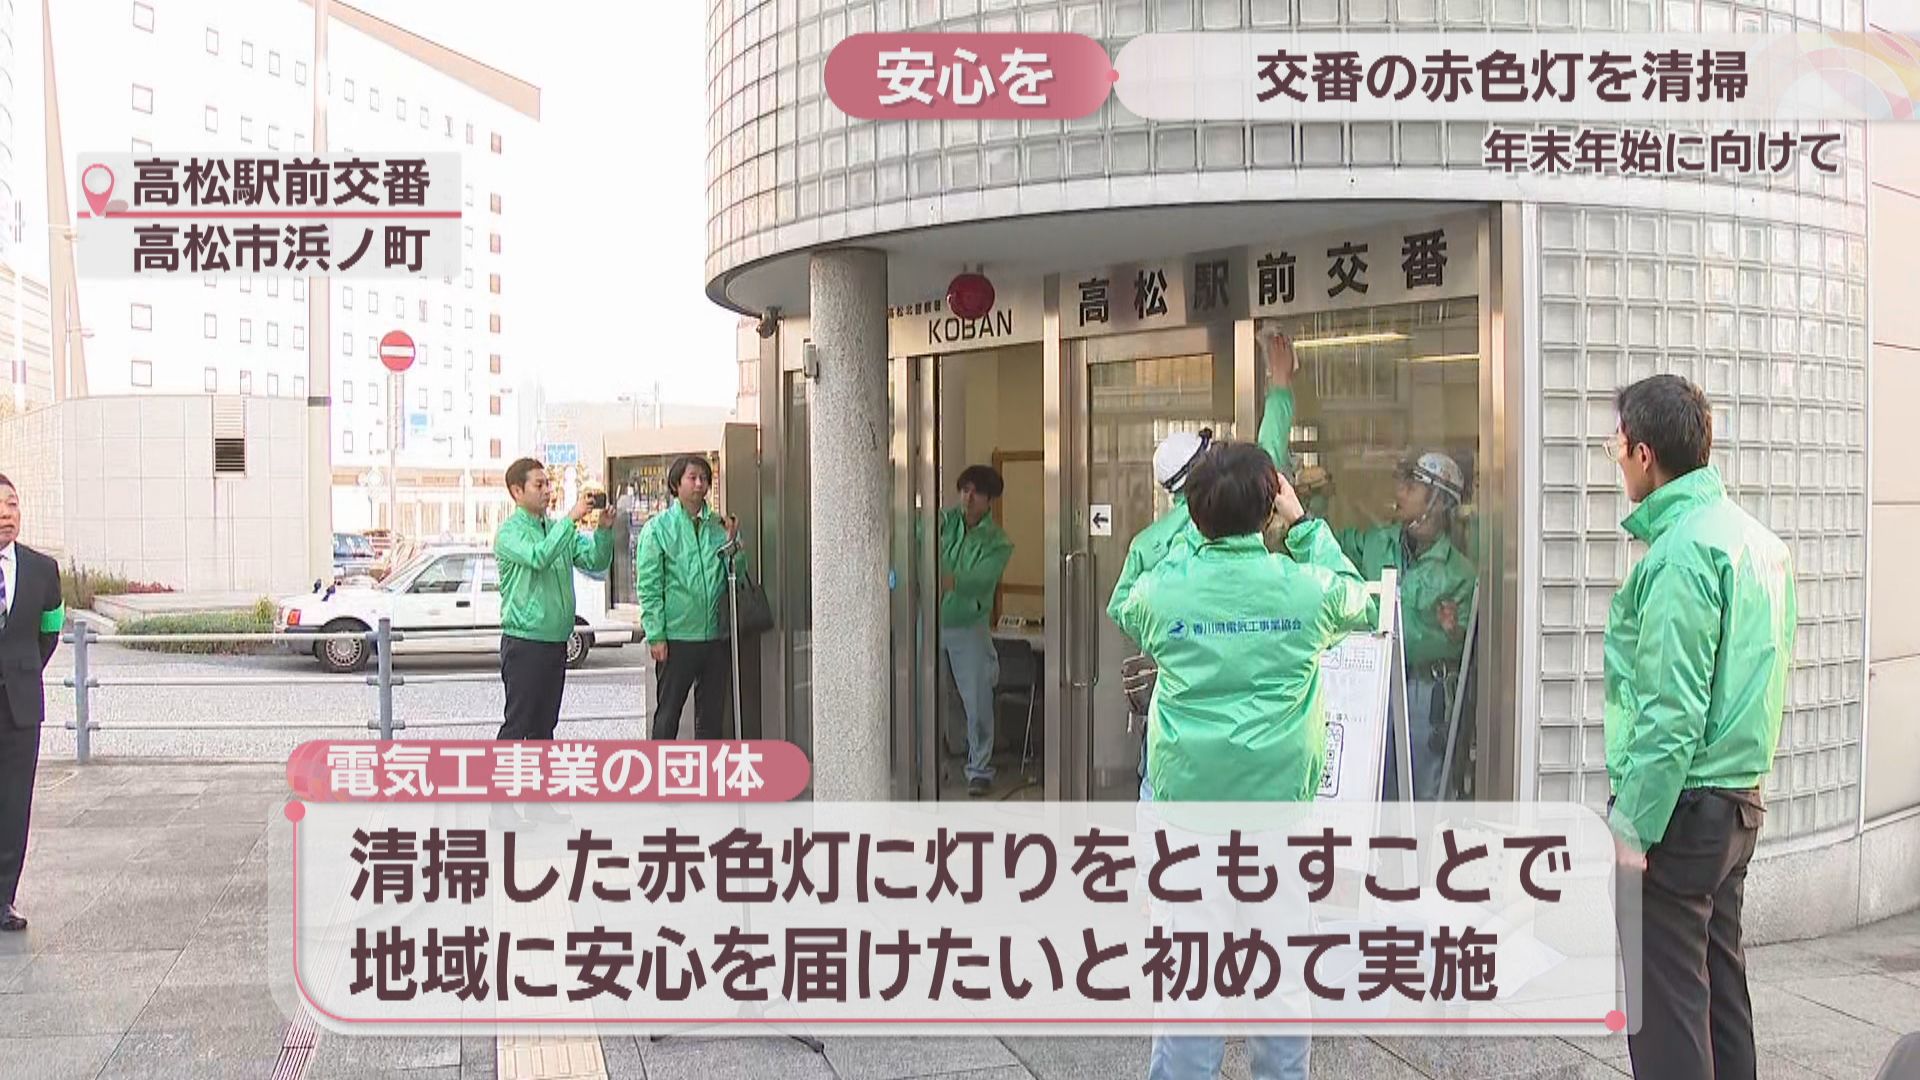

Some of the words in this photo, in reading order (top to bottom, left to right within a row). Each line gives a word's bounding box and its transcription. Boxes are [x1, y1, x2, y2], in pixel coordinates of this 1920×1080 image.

[1077, 228, 1448, 328] 高松駅前交番
[928, 308, 1013, 344] KOBAN
